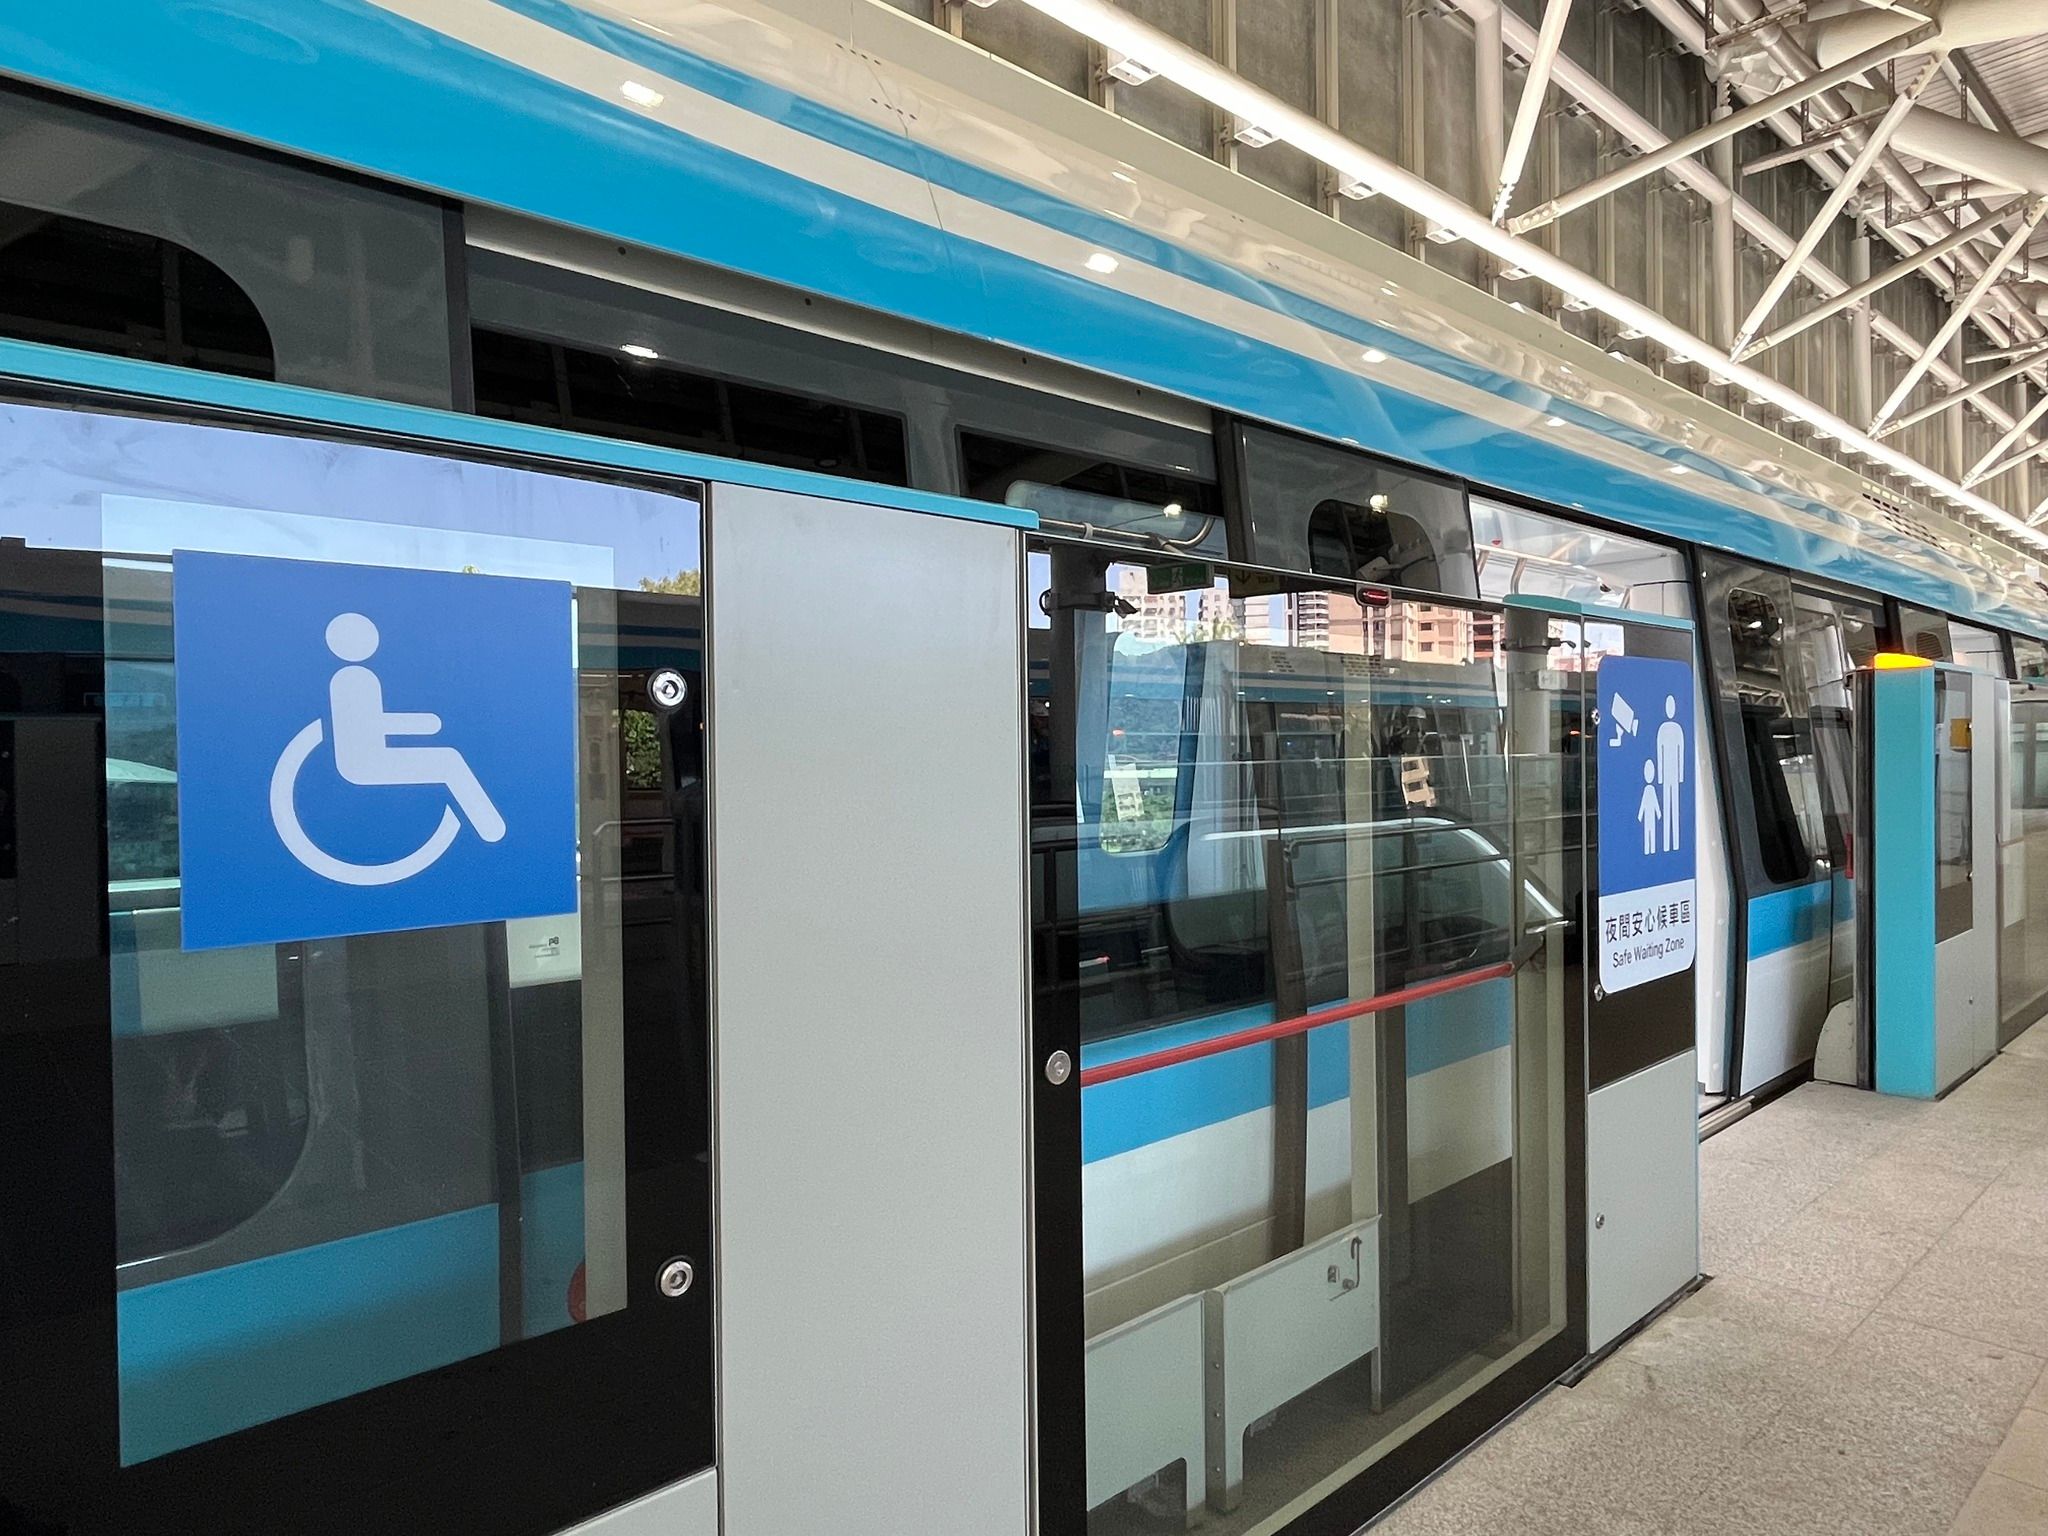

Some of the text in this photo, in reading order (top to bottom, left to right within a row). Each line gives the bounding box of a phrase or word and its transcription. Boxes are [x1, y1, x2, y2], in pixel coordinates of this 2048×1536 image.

[1605, 900, 1690, 943] 夜間安心候車區
[1613, 938, 1685, 968] Safe Waiting Zone
